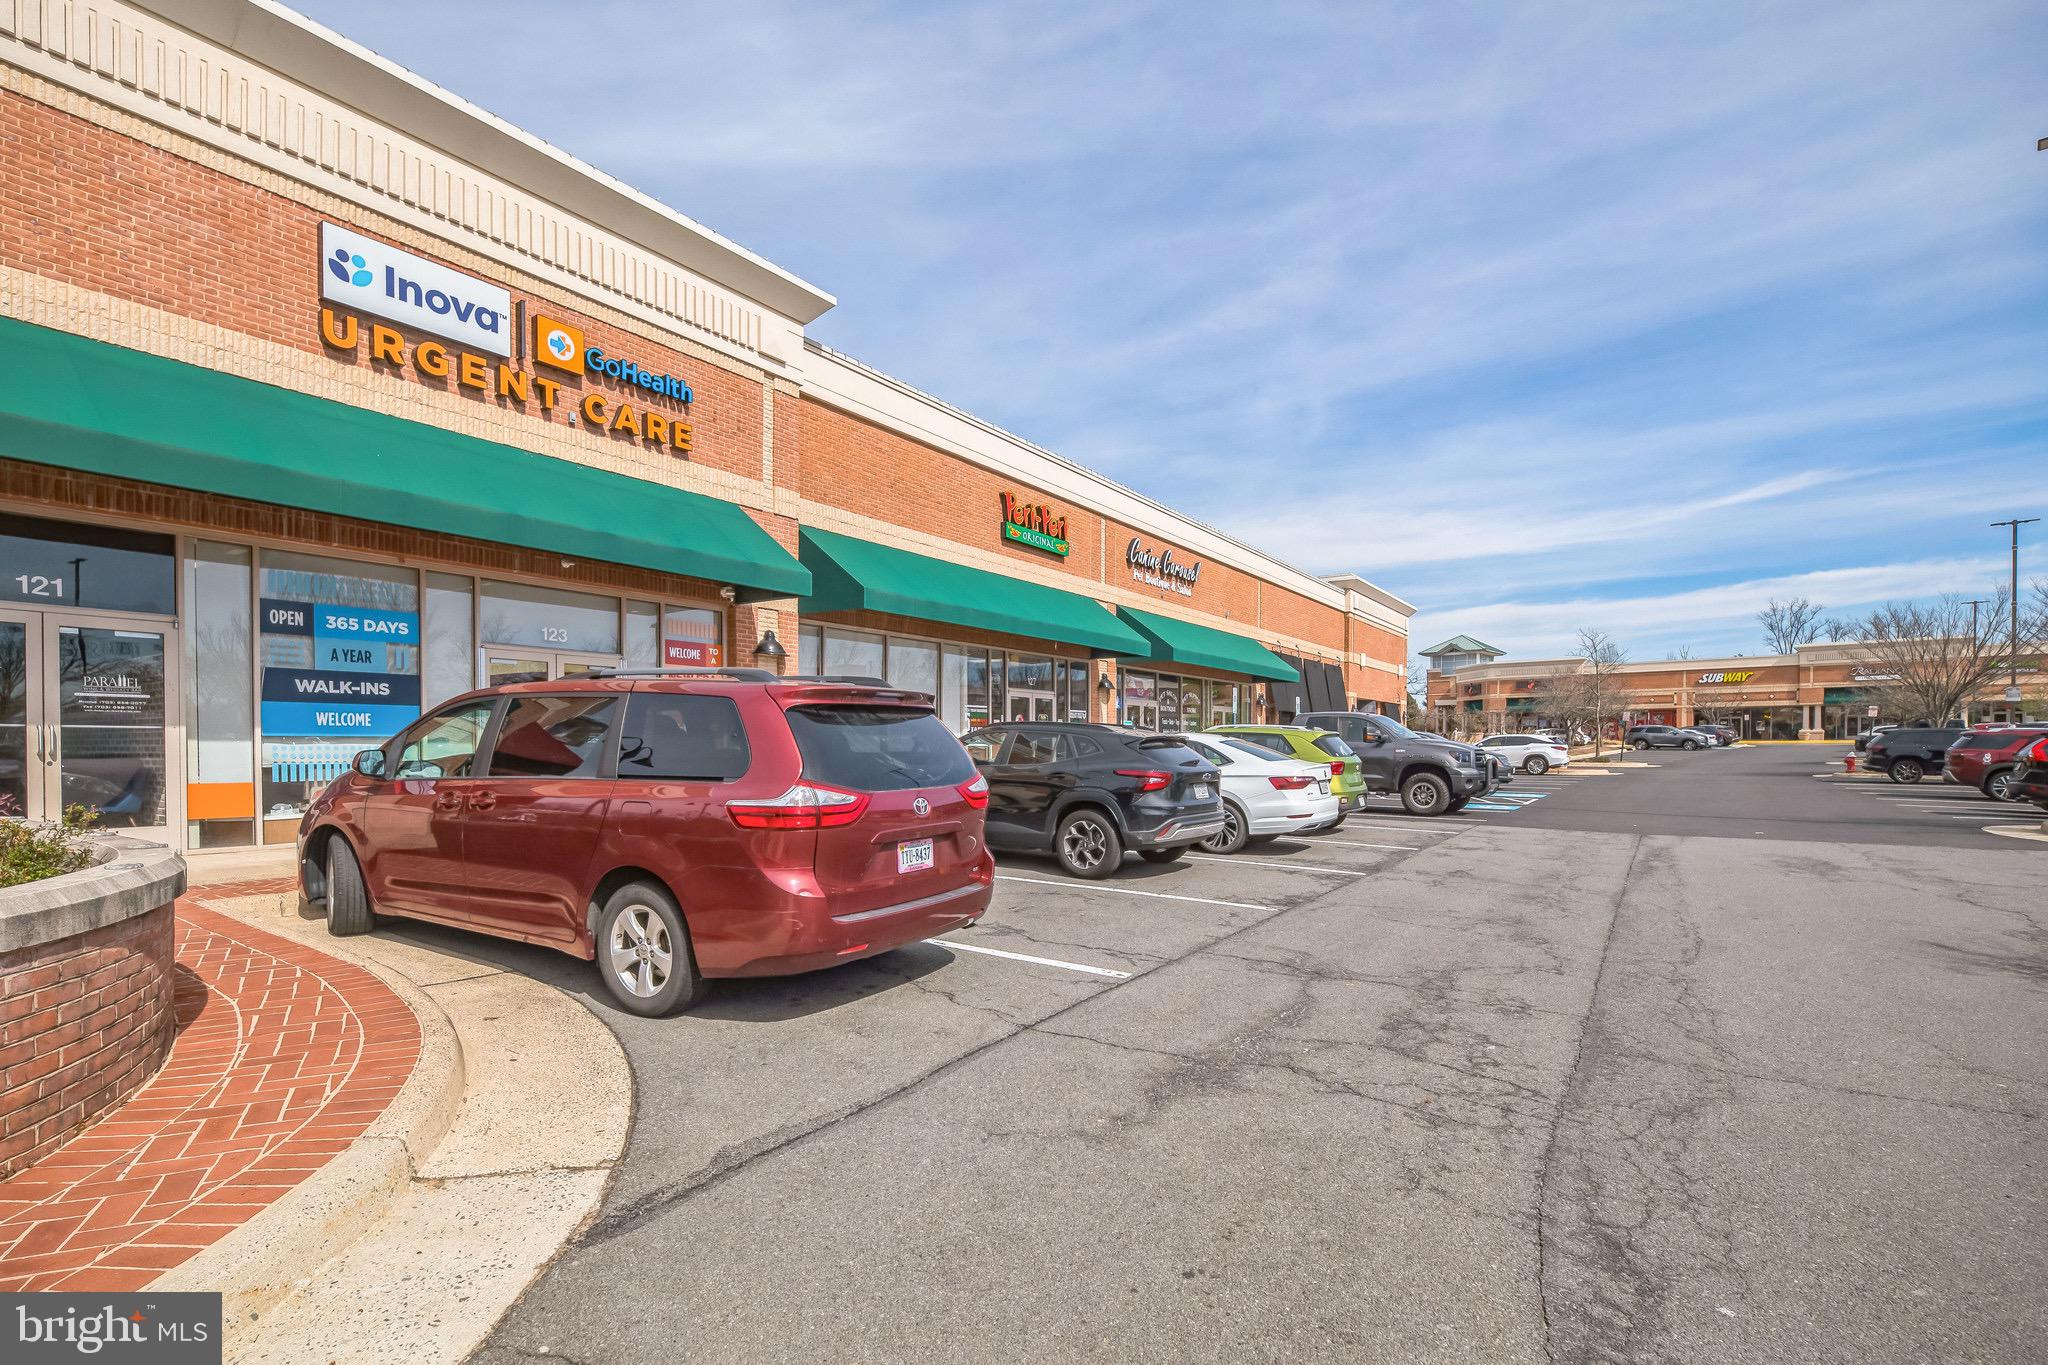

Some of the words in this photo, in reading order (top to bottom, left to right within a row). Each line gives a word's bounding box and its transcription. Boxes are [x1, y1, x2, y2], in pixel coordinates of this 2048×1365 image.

[385, 264, 499, 334] Inova
[321, 308, 562, 410] URGENT
[584, 393, 693, 452] CARE
[585, 346, 693, 404] GoHealth
[15, 574, 64, 598] 121
[269, 609, 304, 627] OPEN
[325, 615, 359, 631] 365
[363, 619, 409, 635] DAYS
[541, 627, 568, 643] 123
[330, 648, 339, 662] A
[342, 648, 372, 664] YEAR
[669, 646, 701, 660] WELCOME
[708, 647, 719, 656] TO
[710, 657, 717, 665] A
[1698, 671, 1753, 684] SUBWAY
[294, 678, 391, 696] WALK-INS
[316, 711, 372, 727] WELCOME
